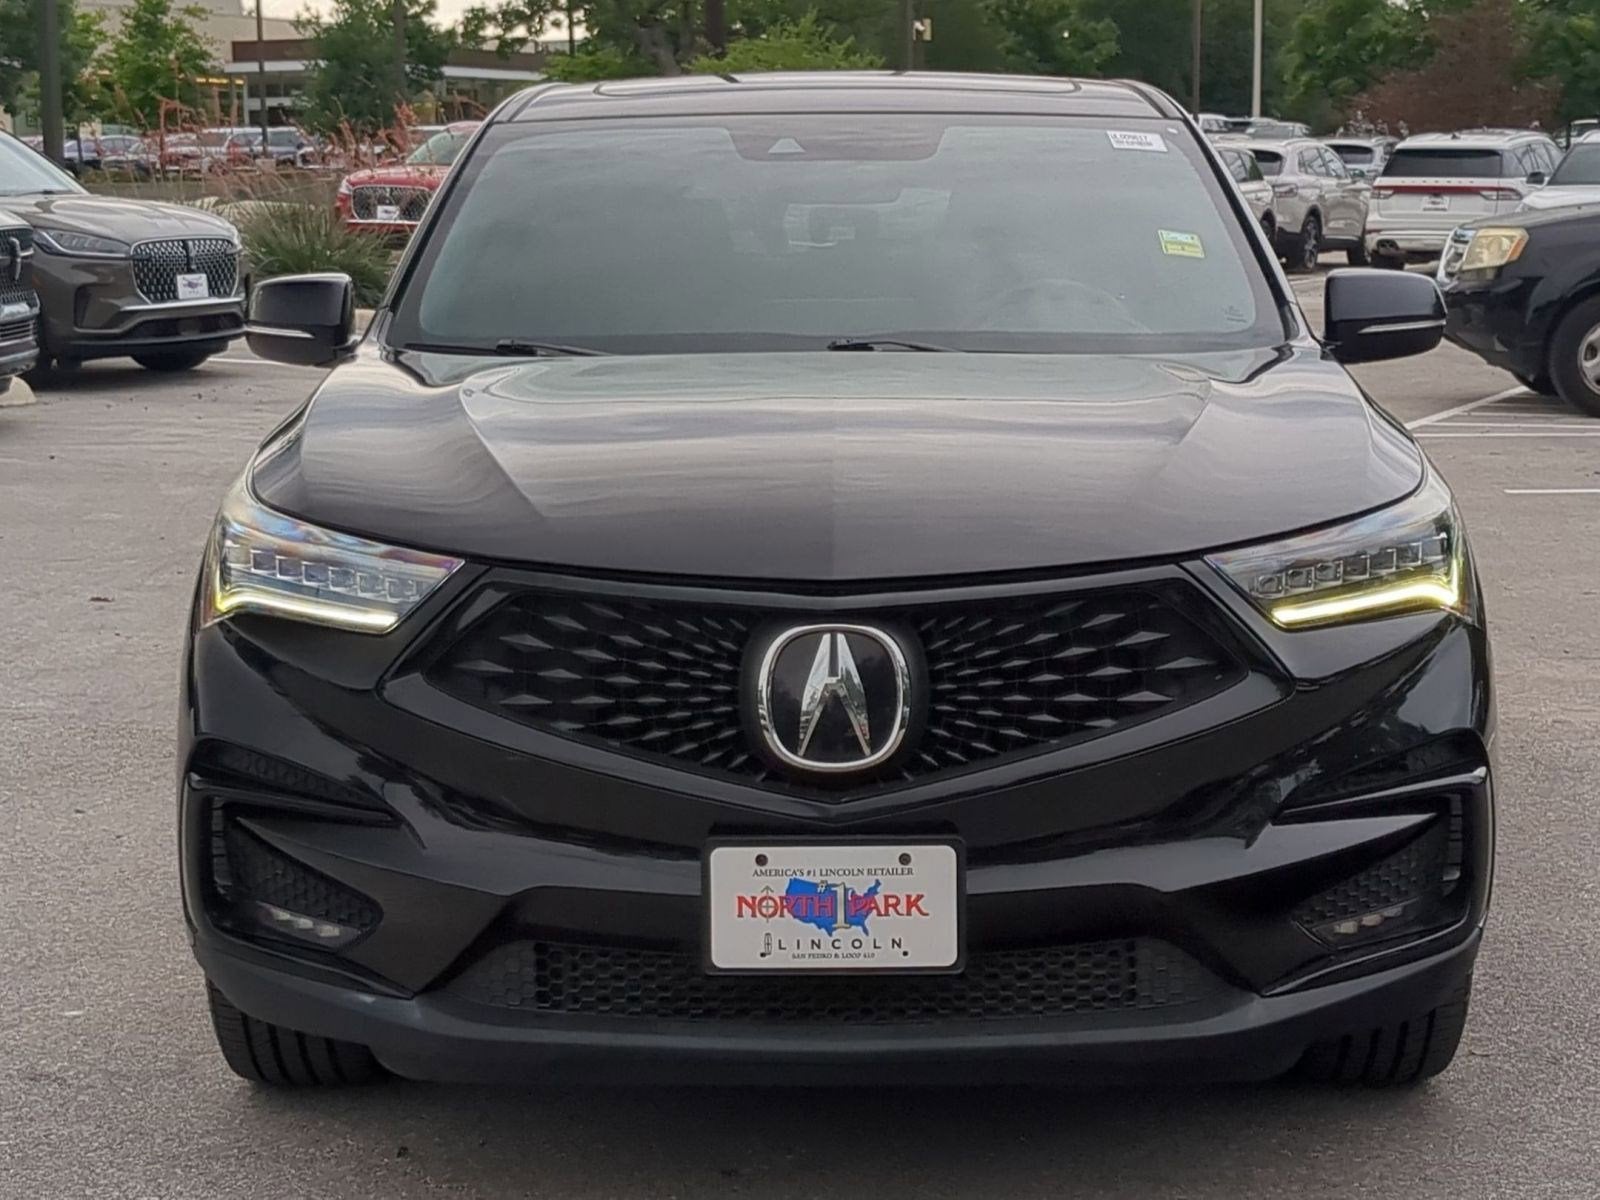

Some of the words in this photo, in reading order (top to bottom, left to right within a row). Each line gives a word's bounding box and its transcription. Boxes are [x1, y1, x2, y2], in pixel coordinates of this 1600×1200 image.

[752, 868, 805, 877] AMERICA'S
[806, 868, 816, 877] #1
[819, 867, 865, 877] LINCOLN
[867, 867, 914, 876] RETAILER
[736, 894, 834, 918] NORTH
[848, 893, 930, 917] PARK
[778, 938, 902, 950] LINCOLN
